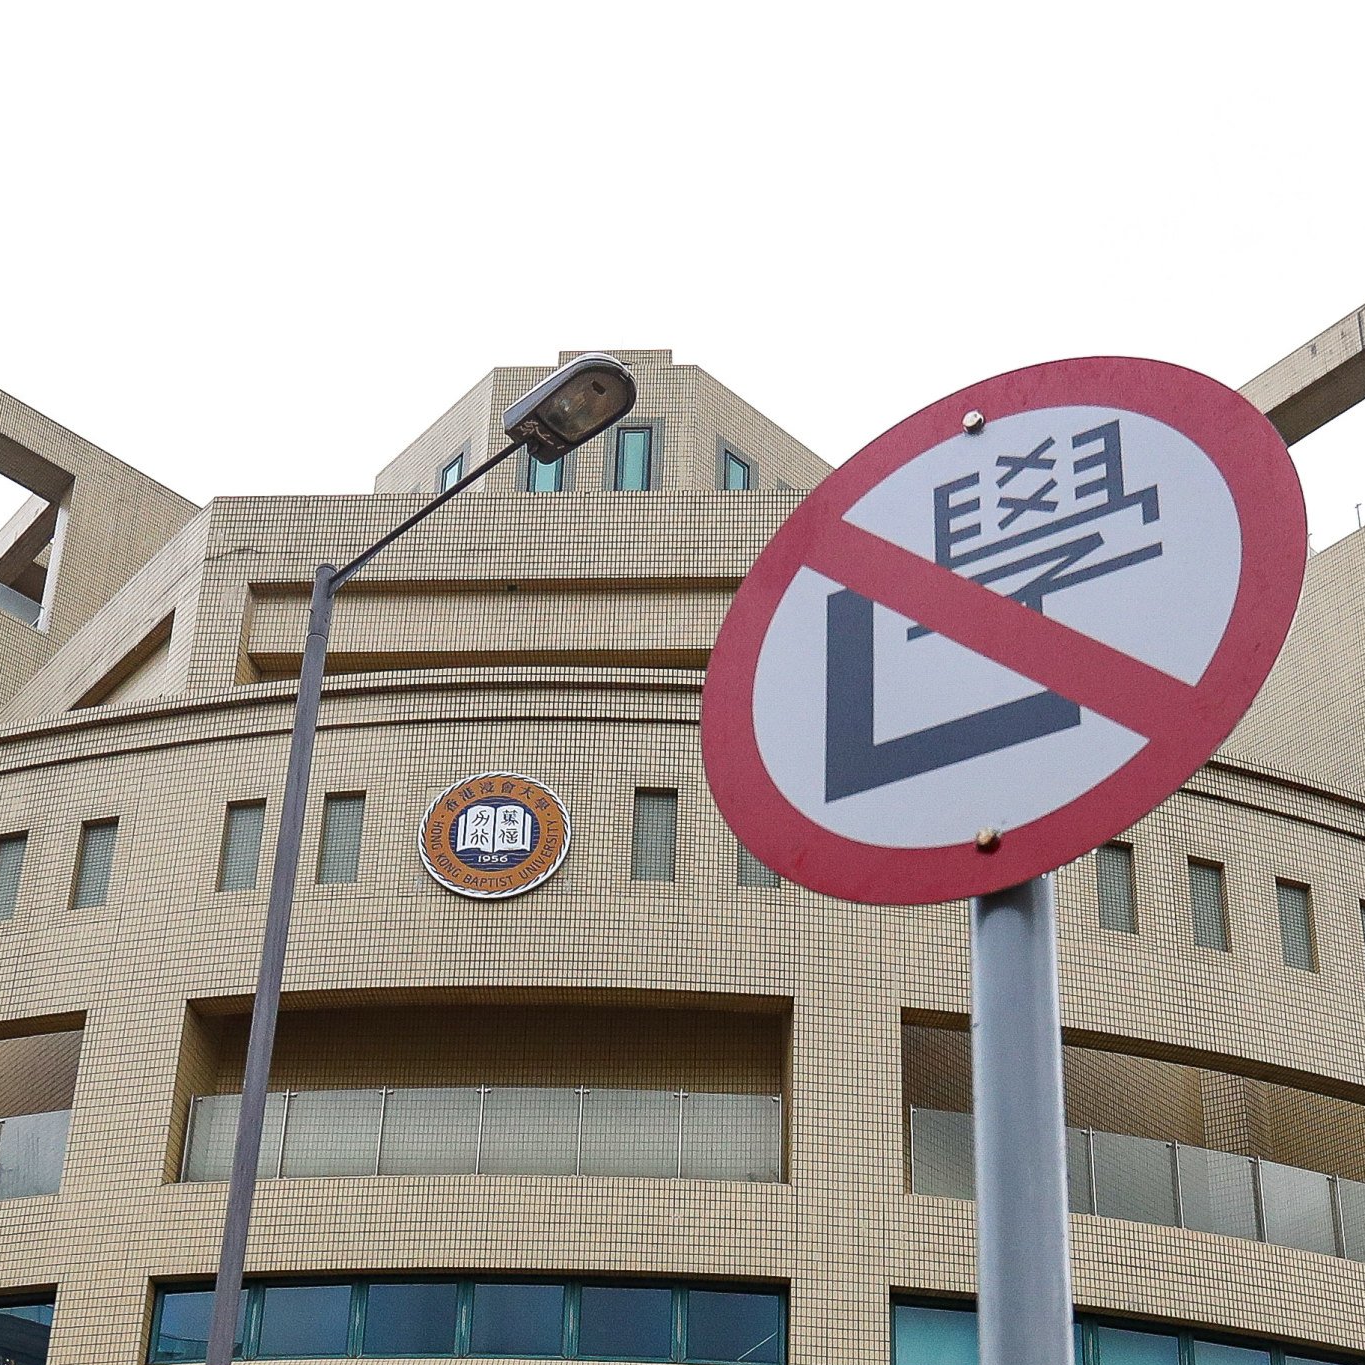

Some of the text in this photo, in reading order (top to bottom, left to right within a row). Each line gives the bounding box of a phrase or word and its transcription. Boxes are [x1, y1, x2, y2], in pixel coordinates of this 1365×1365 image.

[445, 781, 551, 815] 香港浸會大學
[430, 819, 557, 887] HONG KONG BAPTIST UNIVERSITY
[477, 854, 508, 863] 1956
